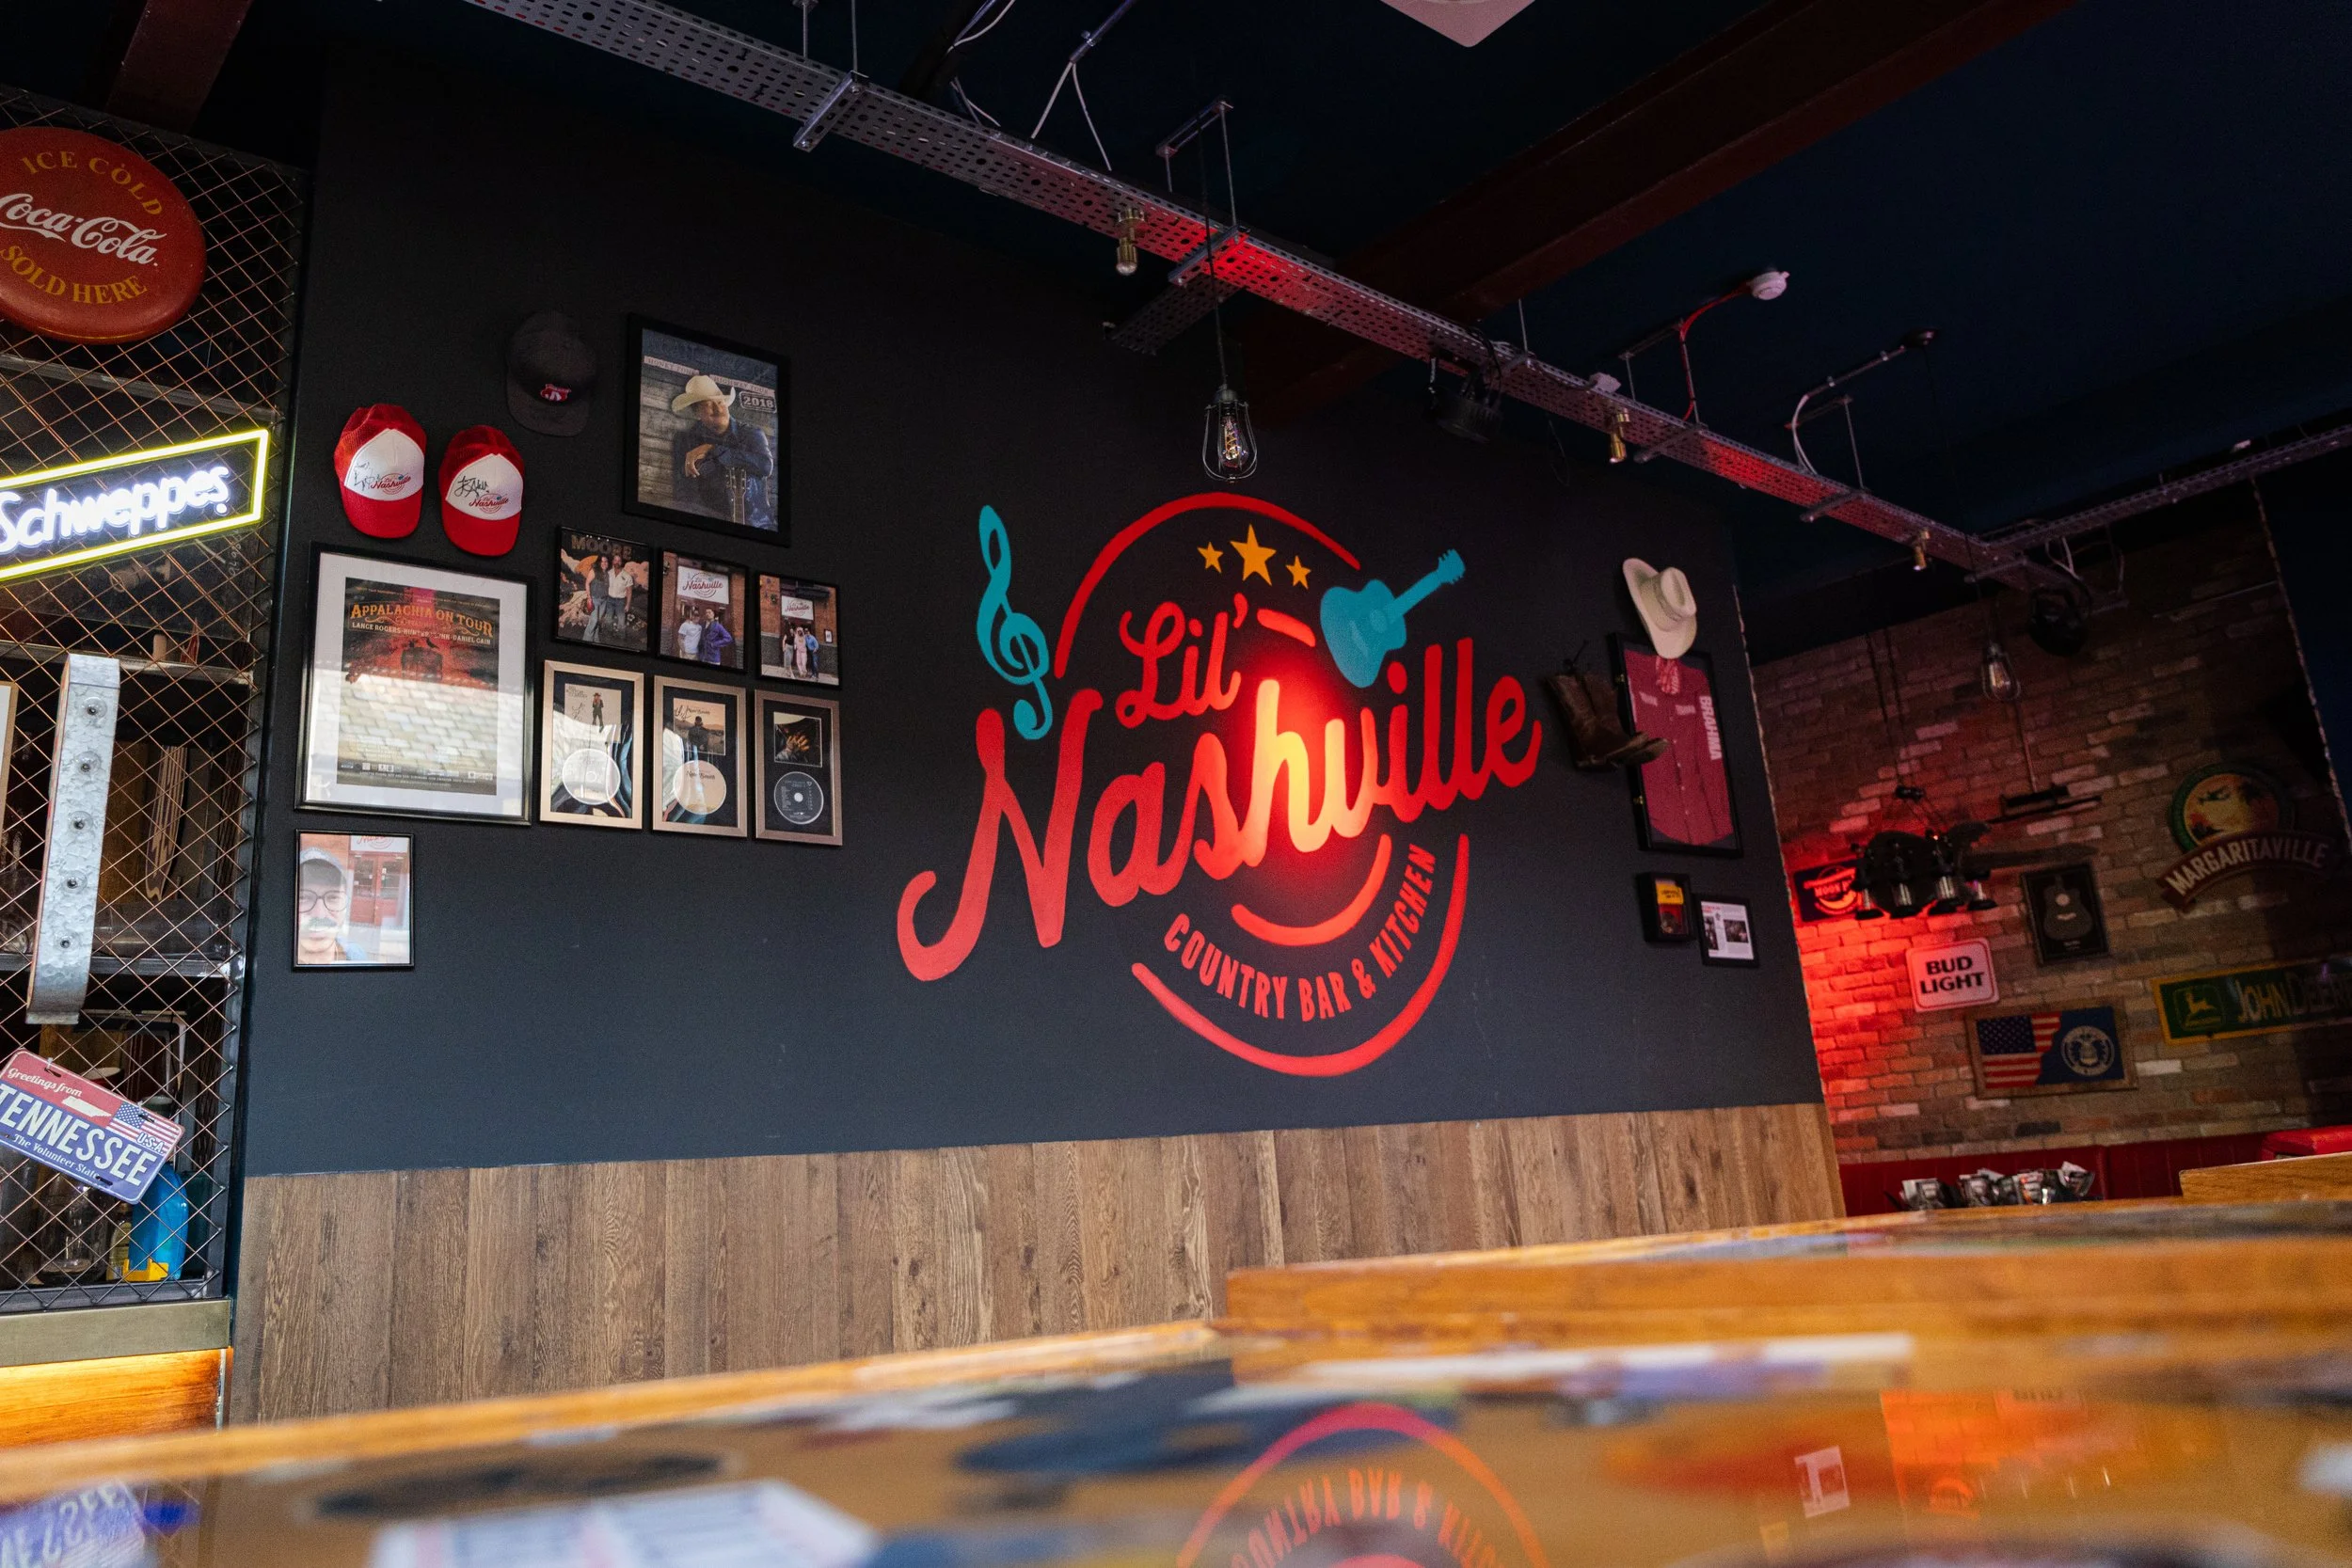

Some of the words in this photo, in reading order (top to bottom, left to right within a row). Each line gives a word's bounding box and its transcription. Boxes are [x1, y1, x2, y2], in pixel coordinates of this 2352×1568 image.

[21, 150, 77, 175] ICE
[89, 157, 163, 215] COLD
[0, 193, 167, 265] Coca-Cola
[1, 245, 67, 296] SOLD
[73, 274, 148, 304] HERE
[743, 396, 774, 409] 2018
[371, 476, 411, 488] Nashville
[469, 497, 509, 507] Nashville
[0, 466, 230, 555] Schweppes
[682, 579, 723, 592] Nashville
[350, 604, 434, 619] APPALACHIA
[436, 609, 453, 621] ON
[456, 613, 494, 639] TOUR
[352, 622, 374, 631] LANCE
[374, 625, 401, 634] ROGERS
[453, 634, 475, 643] DANIEL
[1116, 594, 1249, 728] Lil'
[897, 638, 1543, 981] Nashville
[2166, 838, 2328, 896] MARGARITAVILLE
[1164, 913, 1288, 1020] COUNTRY
[1298, 972, 1352, 1022] BAR
[1351, 958, 1376, 999] &
[1368, 844, 1437, 978] KITCHEN
[1920, 971, 1985, 994] LIGHT
[1926, 955, 1974, 976] BUD
[2234, 978, 2292, 1024] JOHN
[8, 1068, 56, 1092] Greetings
[55, 1081, 83, 1098] from
[0, 1085, 158, 1187] TENNESSEE
[13, 1133, 32, 1148] The
[33, 1142, 75, 1170] Volunteer
[75, 1163, 100, 1180] State
[135, 1132, 165, 1155] U.S.A.
